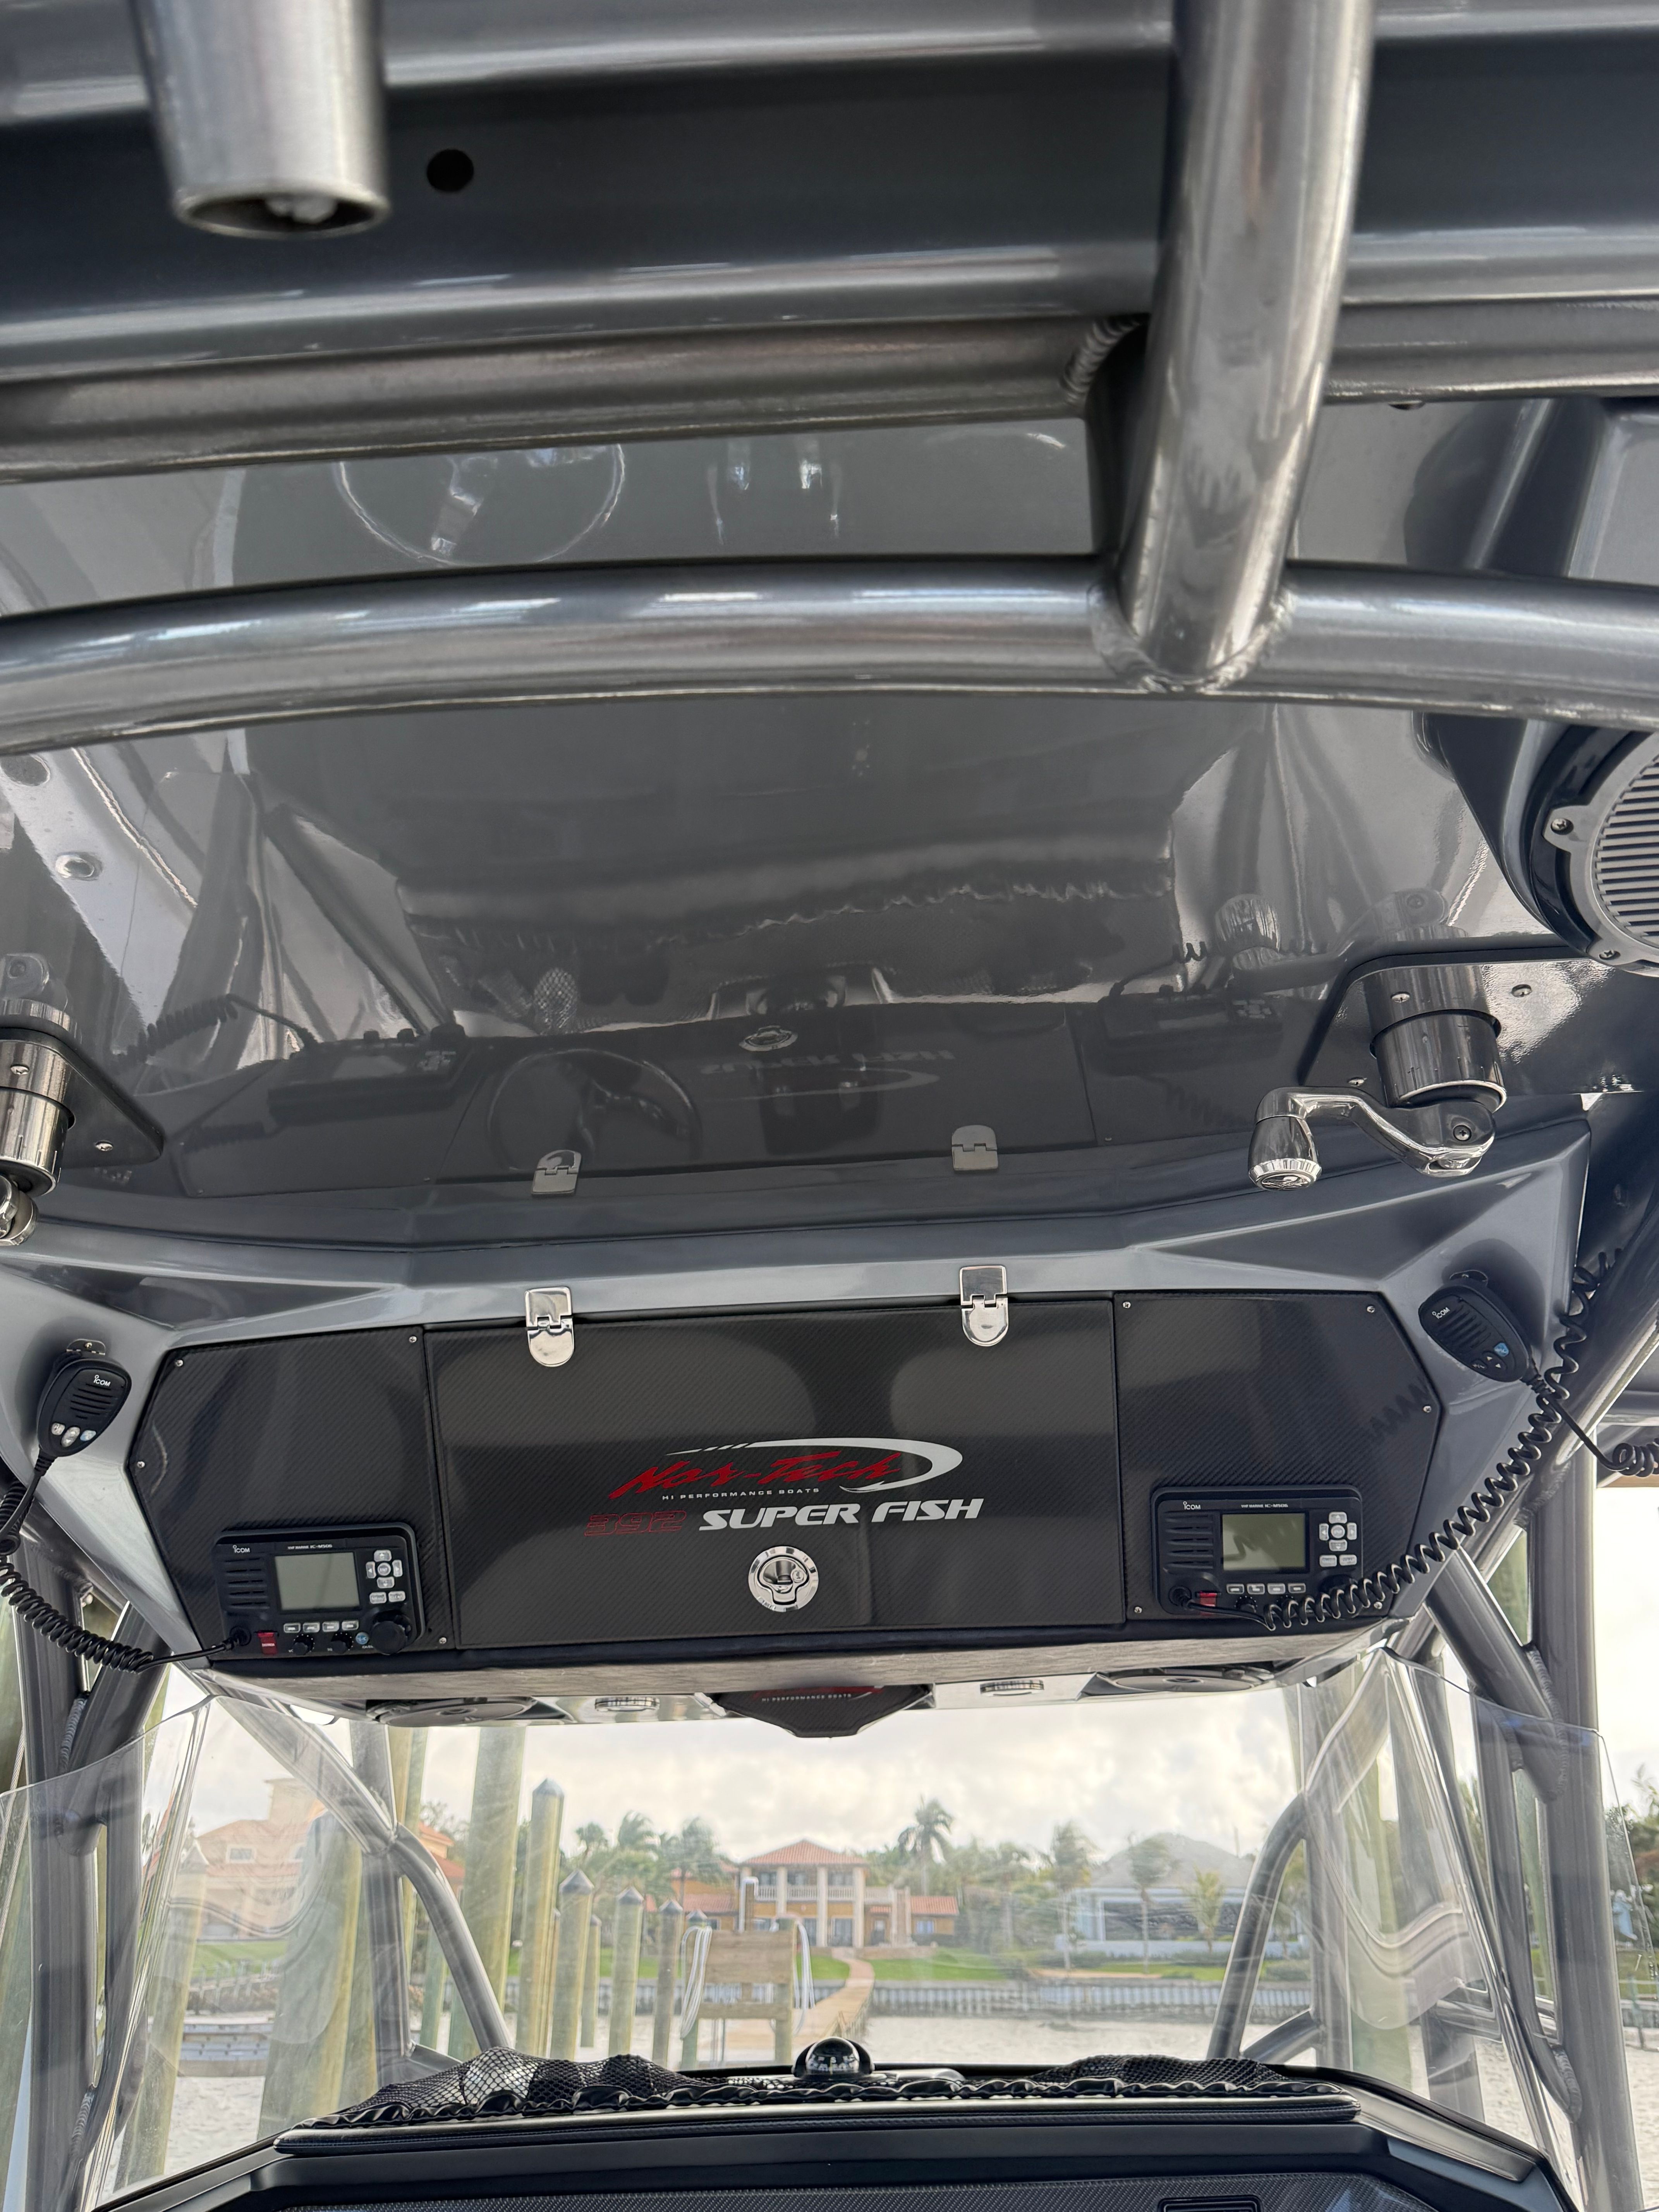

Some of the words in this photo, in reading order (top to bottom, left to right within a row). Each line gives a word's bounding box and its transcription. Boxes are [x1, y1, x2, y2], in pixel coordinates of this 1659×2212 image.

[609, 1451, 901, 1499] Nor-Tech
[680, 1490, 773, 1499] PERFORMANCE
[584, 1510, 687, 1536] 392
[699, 1503, 860, 1531] SUPER
[871, 1498, 984, 1523] FISH
